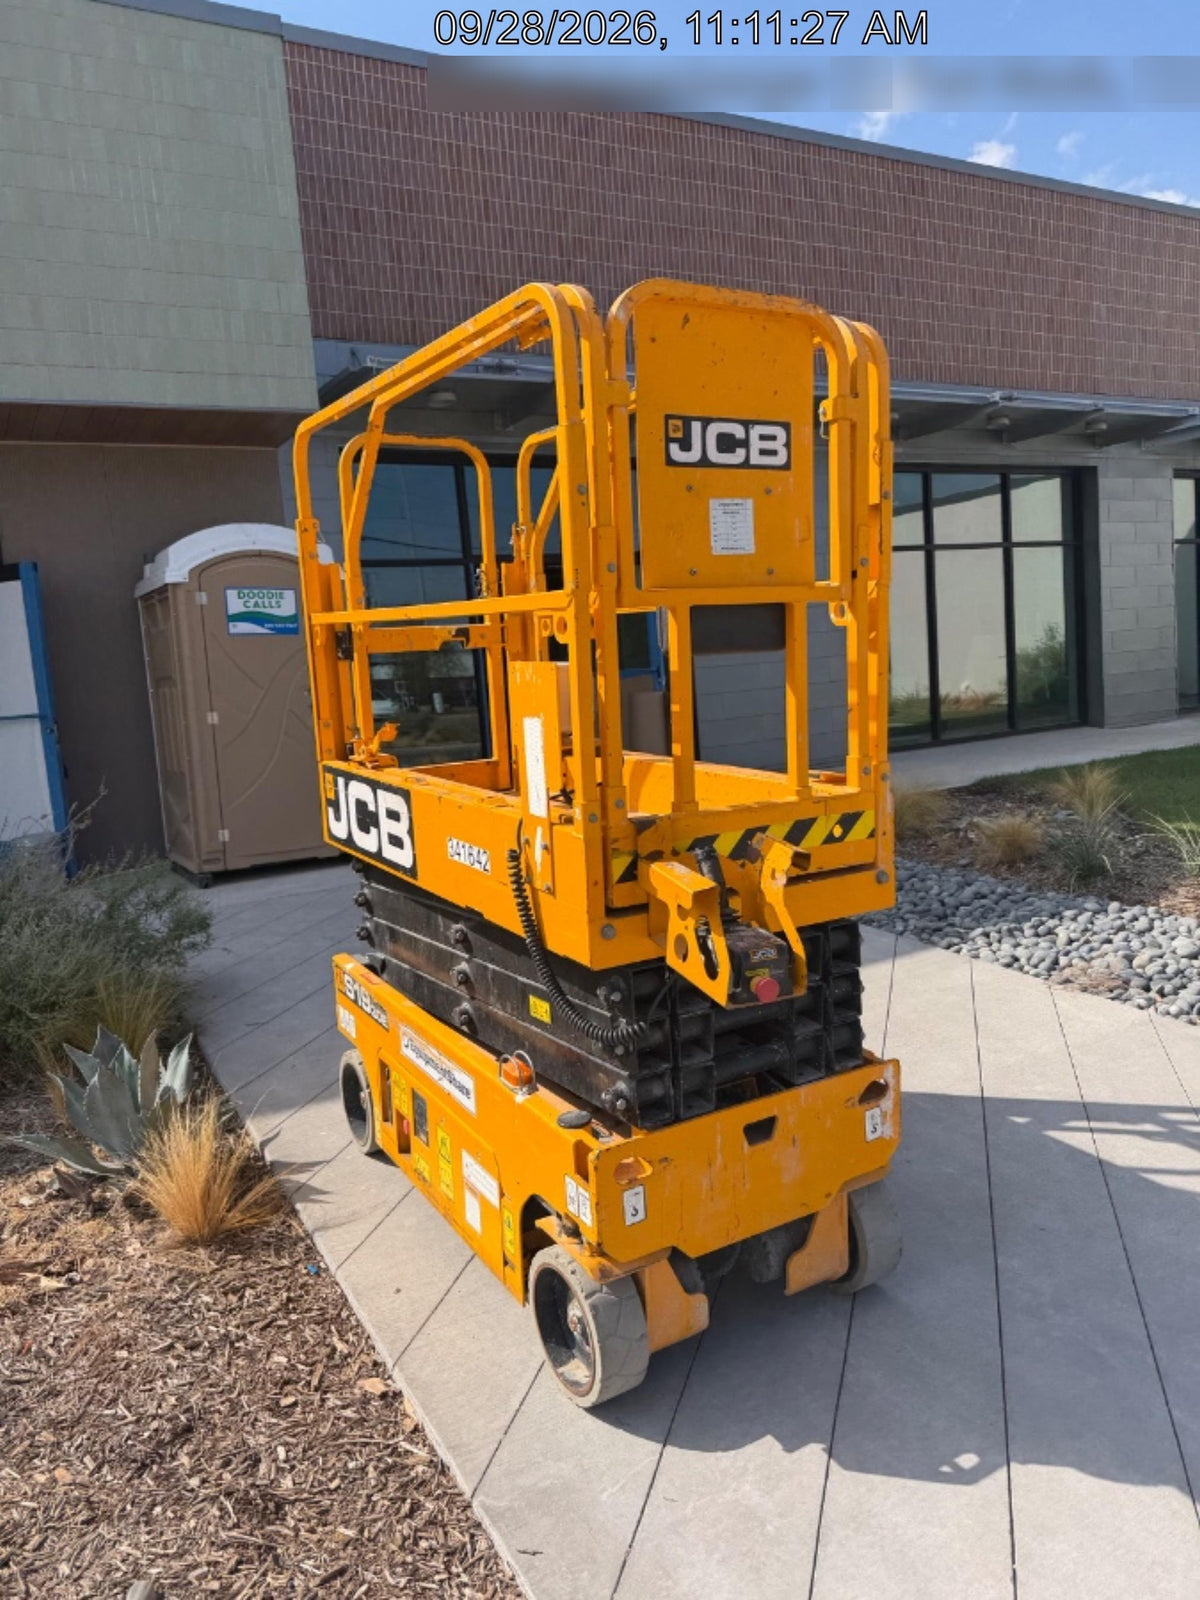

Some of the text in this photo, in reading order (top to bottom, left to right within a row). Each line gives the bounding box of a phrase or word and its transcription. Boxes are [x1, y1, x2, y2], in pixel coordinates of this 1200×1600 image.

[669, 421, 788, 466] JCB
[237, 590, 285, 600] DOODIE
[242, 600, 282, 609] CALLS
[327, 776, 414, 869] JCB
